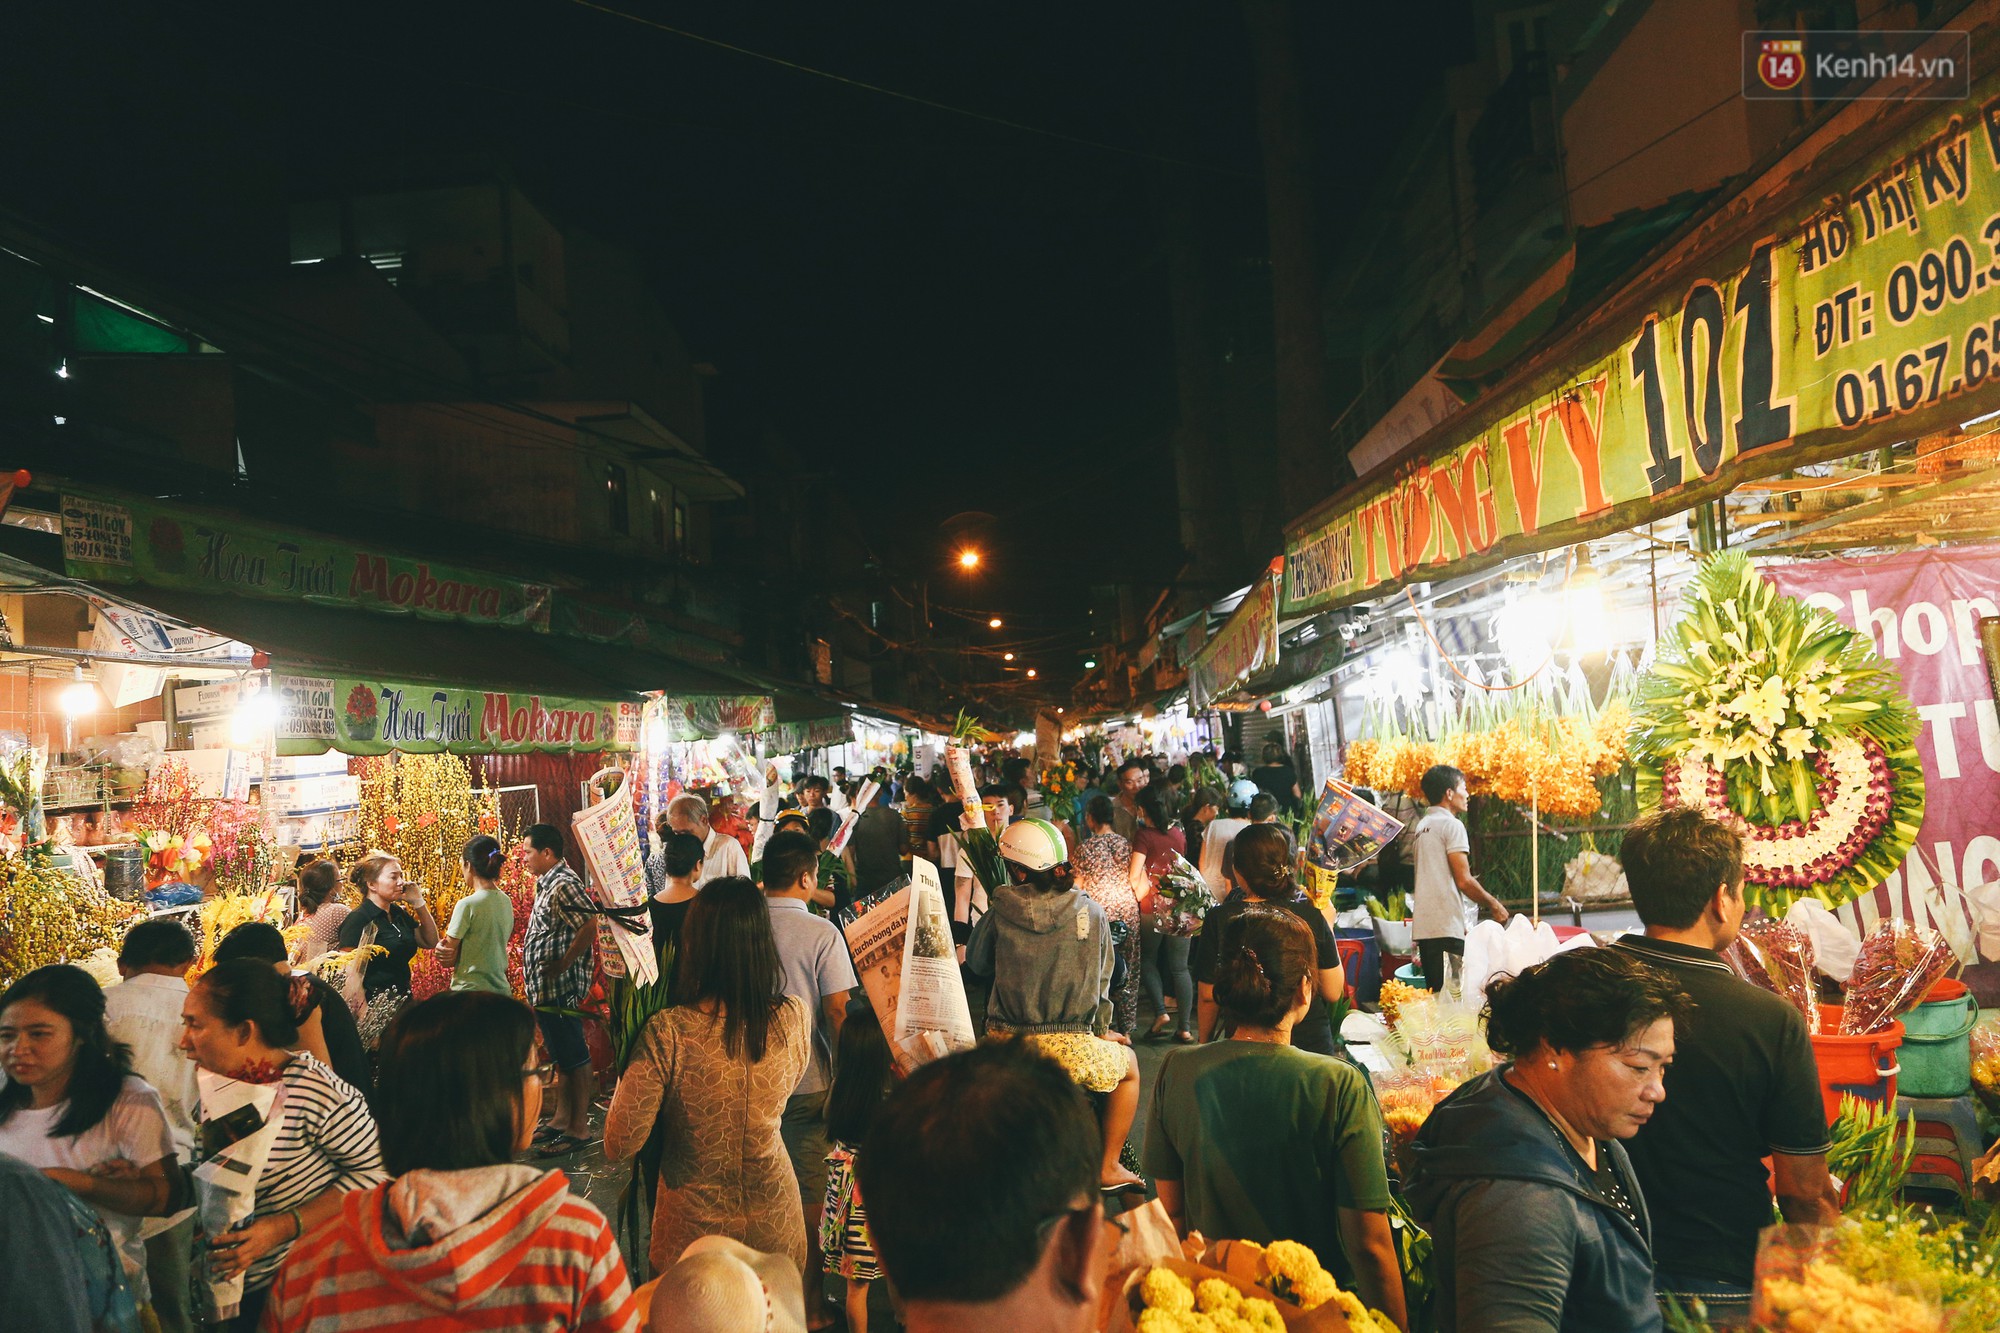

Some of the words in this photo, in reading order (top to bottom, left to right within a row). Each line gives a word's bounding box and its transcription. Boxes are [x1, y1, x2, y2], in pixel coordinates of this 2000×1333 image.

[1803, 198, 1847, 274] Hồ
[1855, 163, 1917, 234] Thị
[1631, 240, 1793, 498] 101
[1815, 283, 1874, 358] ĐT:
[1503, 374, 1614, 535] VY
[195, 528, 271, 587] Hoa
[349, 553, 501, 619] Mokara
[381, 688, 427, 742] Hoa
[431, 691, 473, 743] Tươi
[480, 692, 596, 743] Mokara
